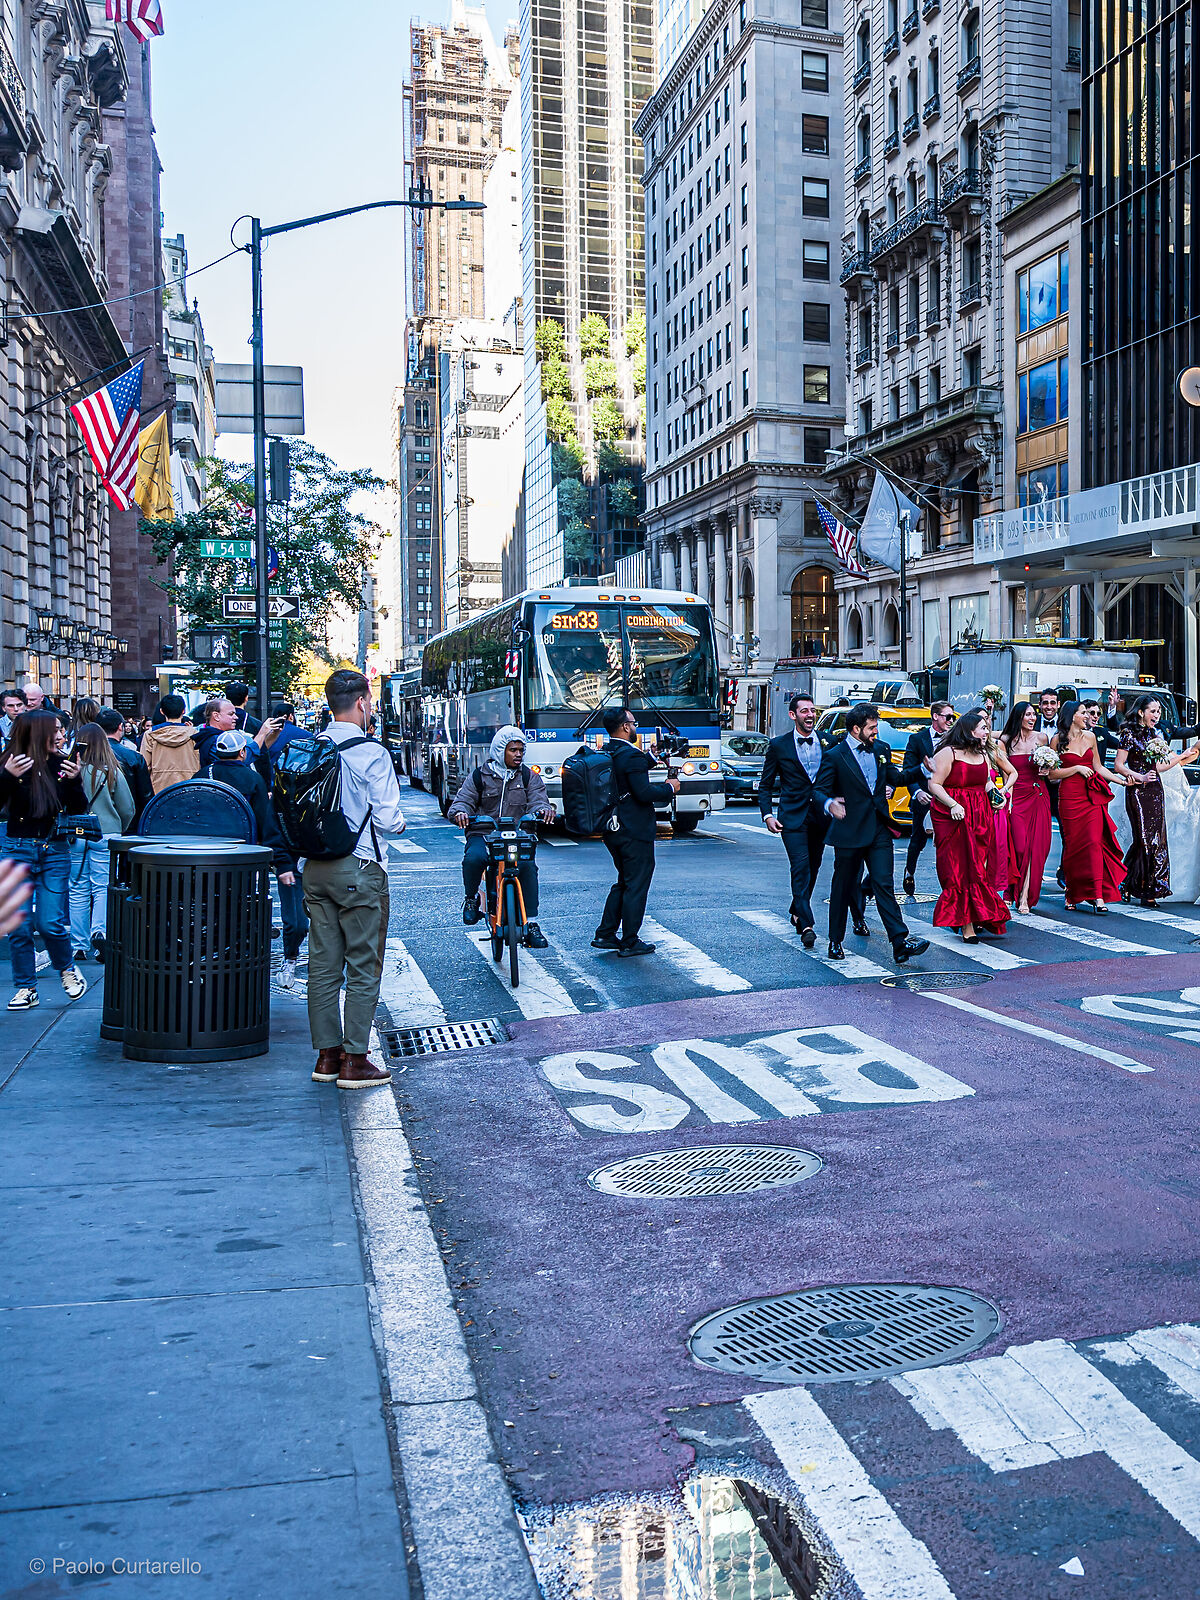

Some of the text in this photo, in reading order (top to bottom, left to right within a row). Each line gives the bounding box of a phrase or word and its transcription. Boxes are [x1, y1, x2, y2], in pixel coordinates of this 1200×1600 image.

[1007, 520, 1020, 539] 693
[205, 541, 248, 556] W 54 St
[232, 602, 285, 611] ONE AY
[552, 610, 599, 630] SIM33
[626, 615, 685, 627] COMBINATION
[268, 630, 283, 638] BM5
[269, 641, 282, 649] MTA
[540, 1024, 977, 1134] BUS
